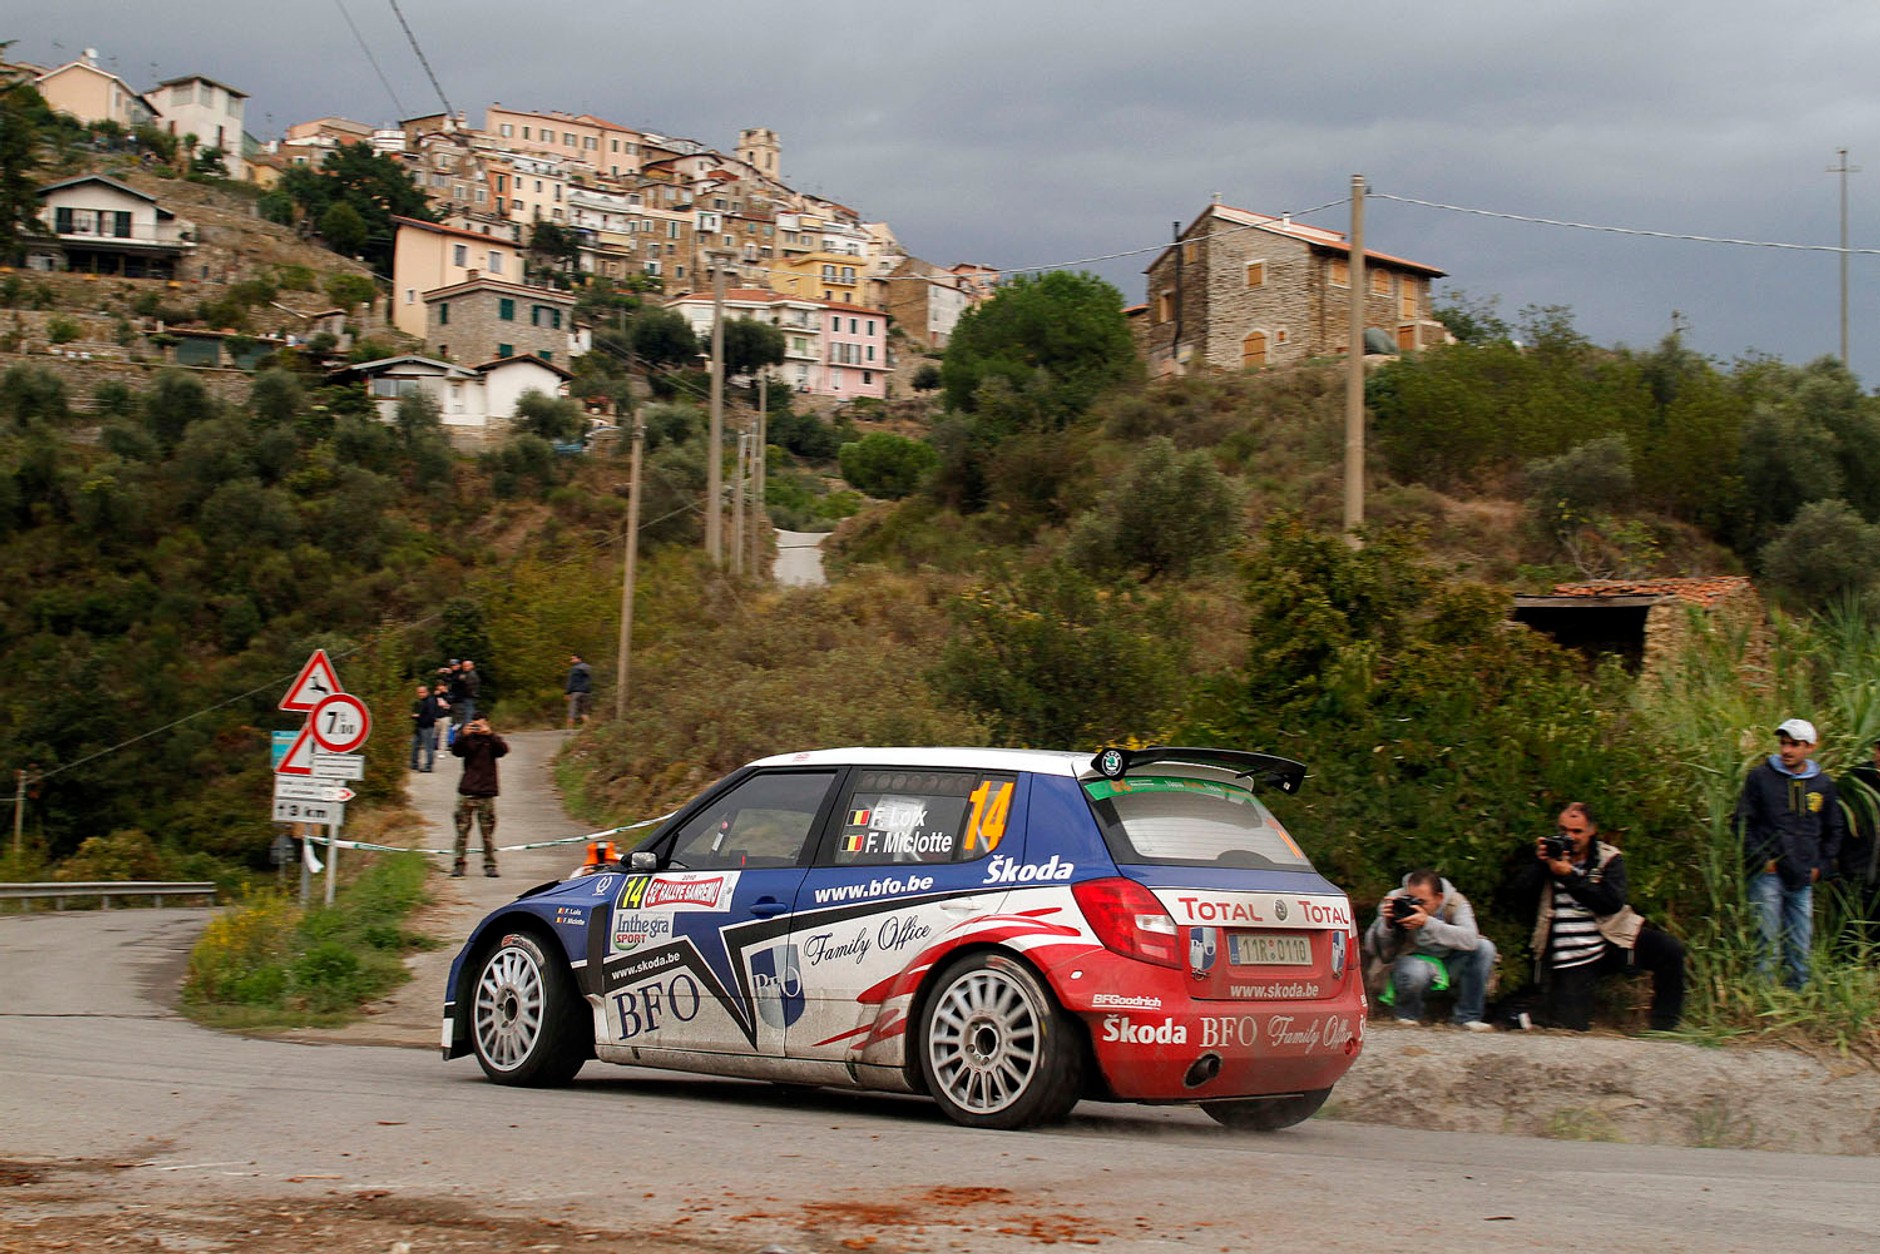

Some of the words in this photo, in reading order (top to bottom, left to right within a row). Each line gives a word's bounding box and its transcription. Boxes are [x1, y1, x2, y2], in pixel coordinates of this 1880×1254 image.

[963, 780, 1016, 852] 14
[865, 831, 879, 853] F.
[883, 831, 953, 854] Miclotte
[983, 854, 1075, 885] Škoda
[622, 876, 649, 909] 14
[814, 875, 934, 904] www.bfo.be
[616, 934, 647, 944] SPORT
[803, 926, 872, 967] Family
[877, 915, 933, 951] Office
[611, 951, 681, 980] www.skoda.be
[1091, 994, 1162, 1007] BFGoodrich
[1230, 981, 1320, 998] www.skoda.be
[611, 973, 701, 1041] BFO
[1102, 1013, 1187, 1045] Škoda
[1199, 1015, 1258, 1048] BFO
[1267, 1014, 1320, 1054] Family
